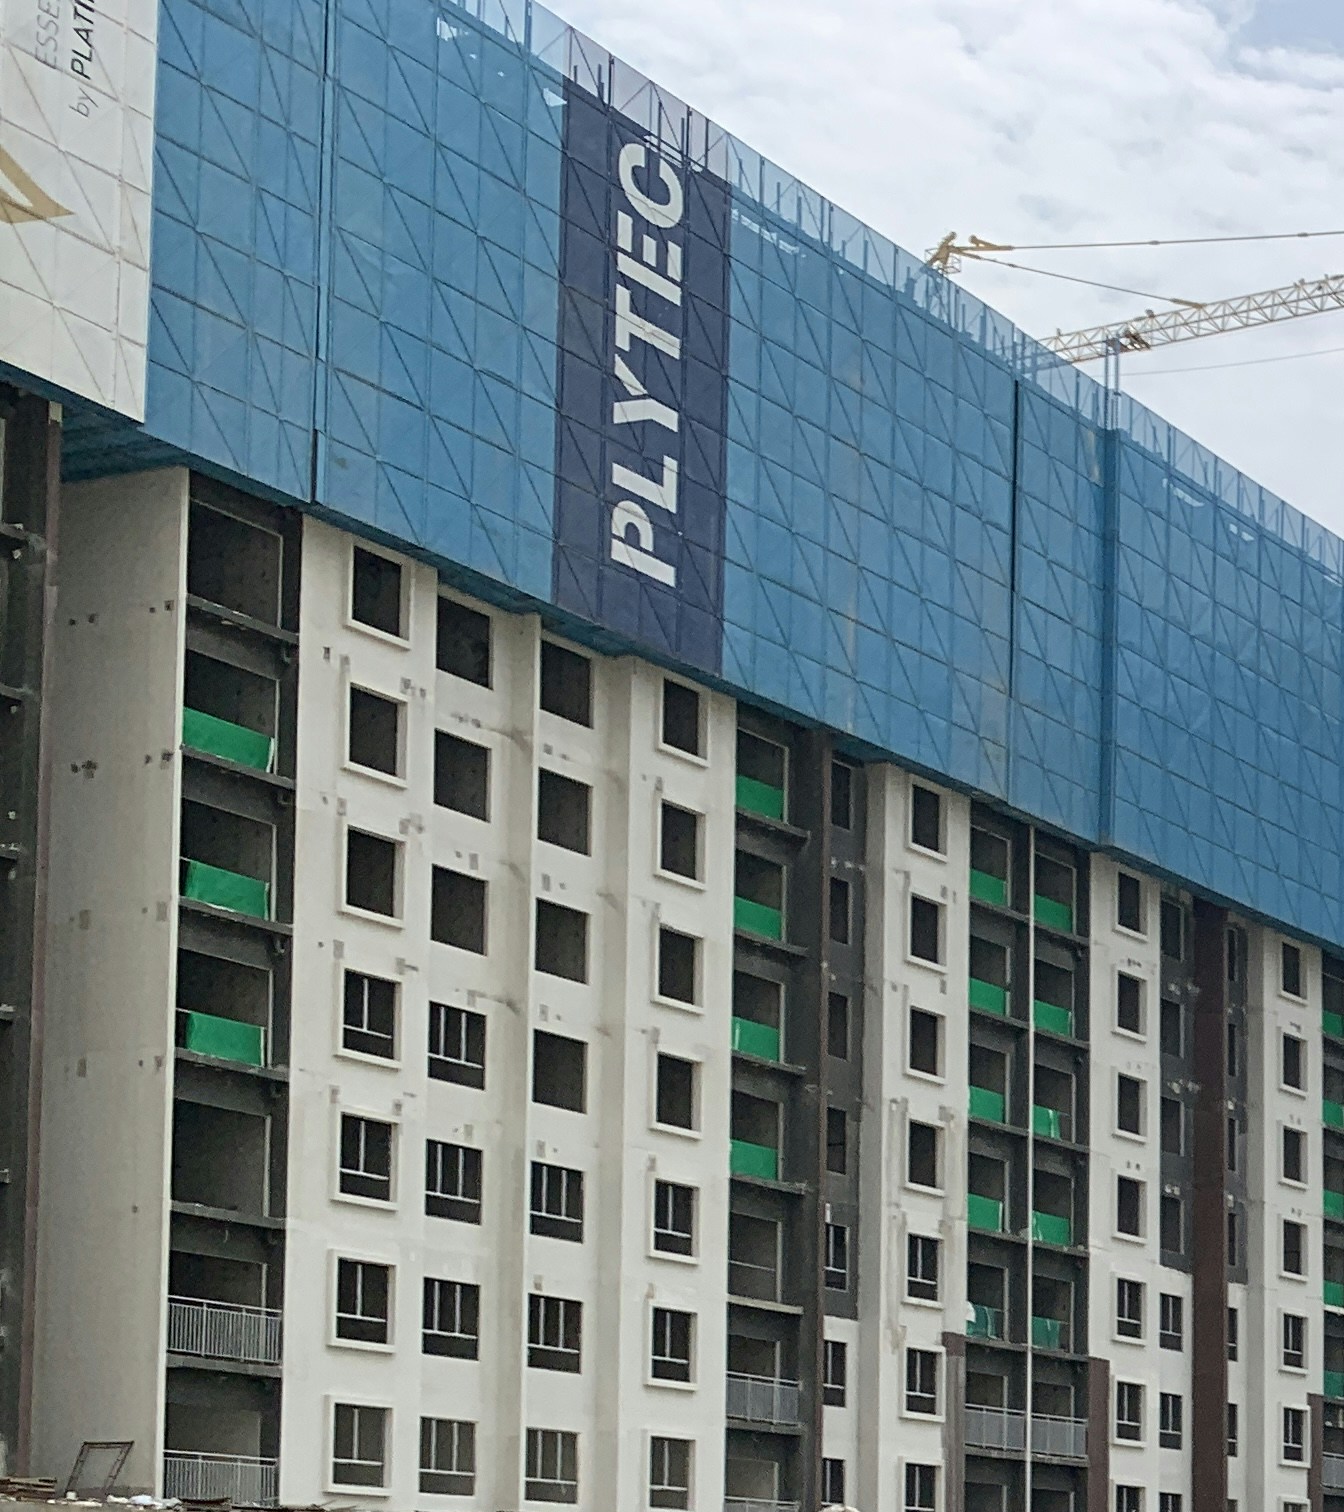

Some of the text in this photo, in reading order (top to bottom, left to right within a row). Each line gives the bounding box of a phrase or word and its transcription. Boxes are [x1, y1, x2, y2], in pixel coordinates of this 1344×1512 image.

[34, 0, 60, 69] ESSE
[68, 0, 99, 118] by PLATI
[610, 142, 684, 588] PLYTEC
